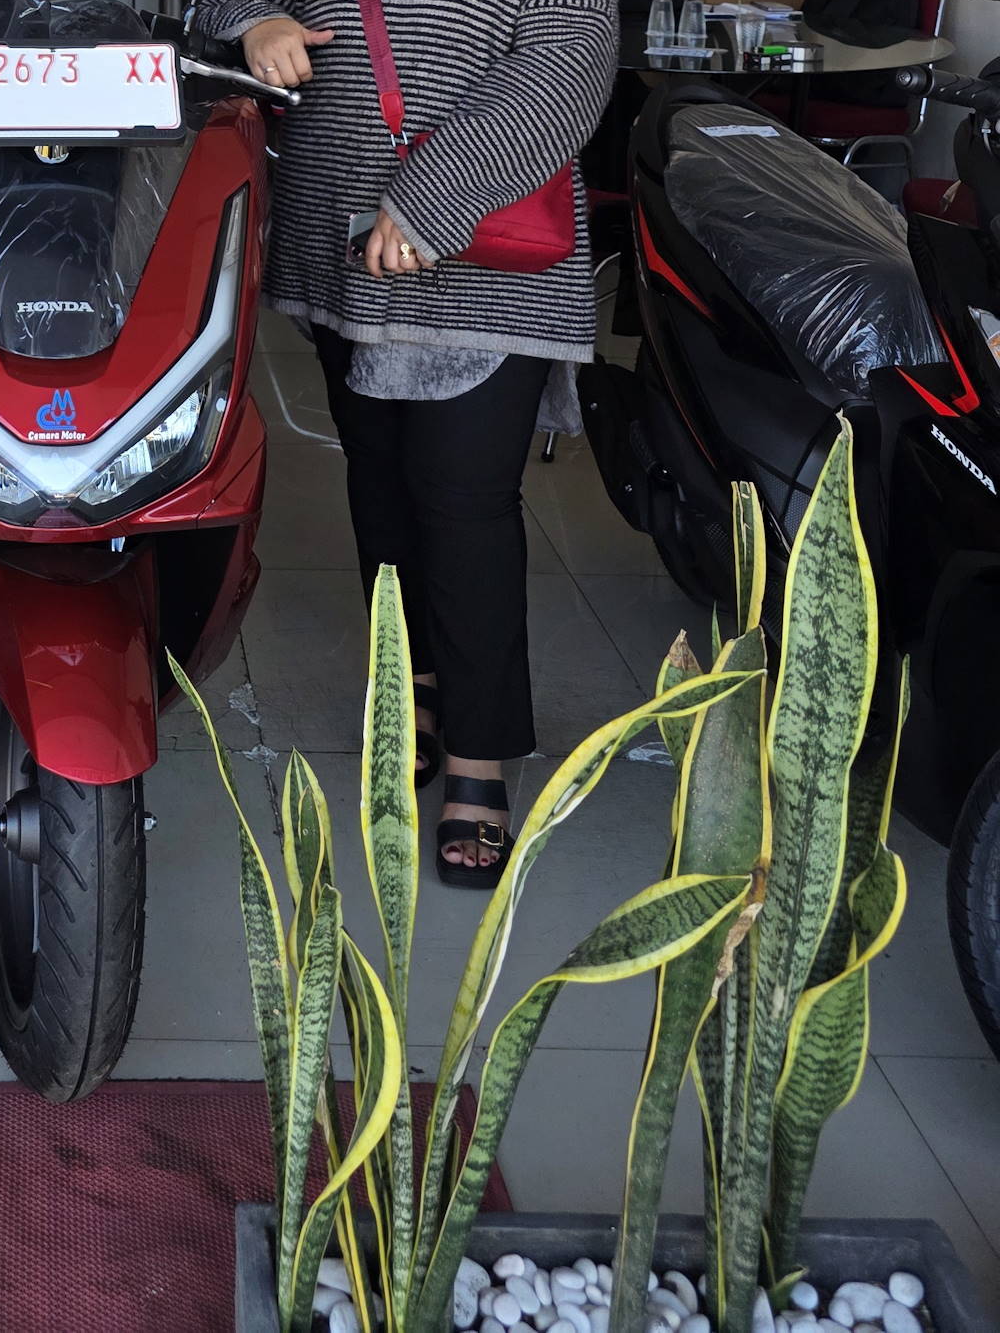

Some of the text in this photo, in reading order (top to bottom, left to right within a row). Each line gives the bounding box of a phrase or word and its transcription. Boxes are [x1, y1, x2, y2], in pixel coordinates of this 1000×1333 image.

[126, 52, 167, 84] XX
[16, 301, 95, 313] HONDA
[28, 431, 87, 441] Cemara Motor
[931, 423, 997, 496] HONDA
